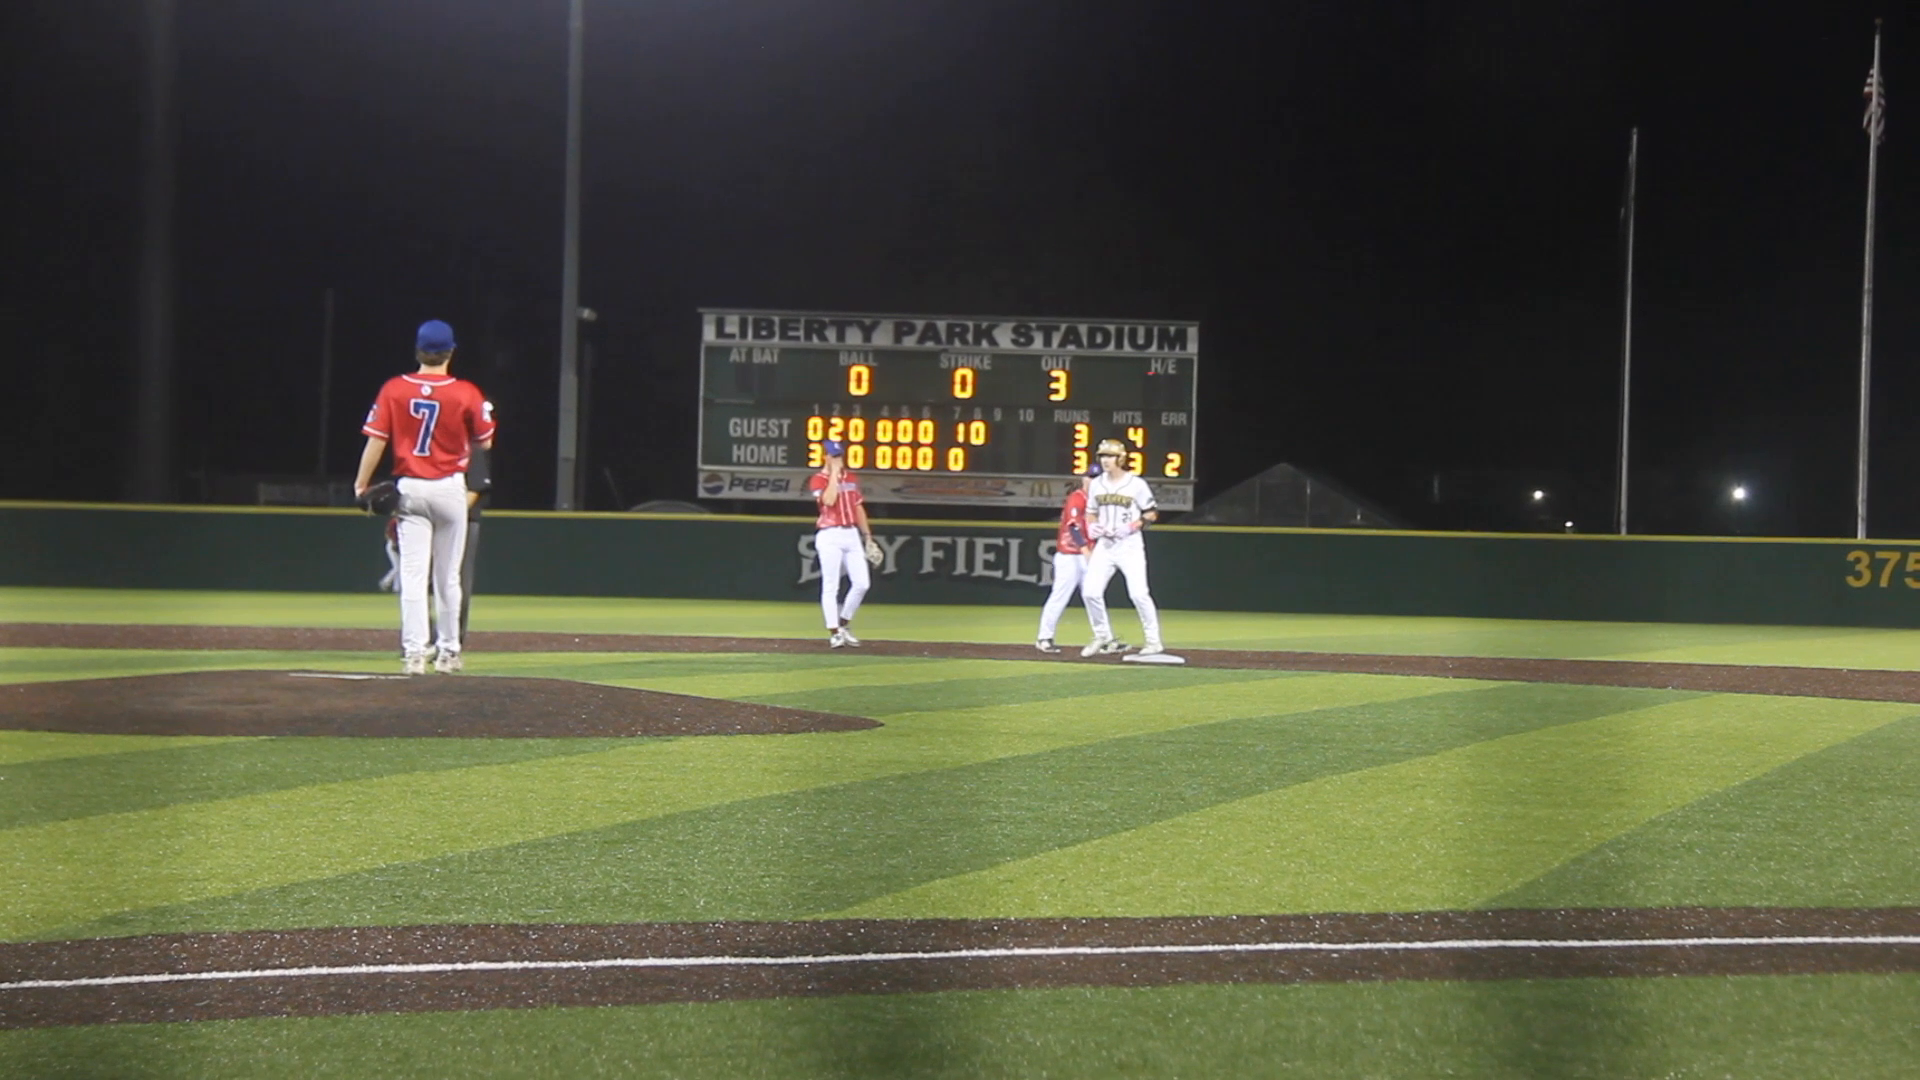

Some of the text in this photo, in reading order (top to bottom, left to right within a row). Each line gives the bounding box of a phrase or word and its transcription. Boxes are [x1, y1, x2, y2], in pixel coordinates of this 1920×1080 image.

[714, 316, 1188, 351] LIBERTY PARK STADIUM
[729, 350, 779, 364] AT BAT
[839, 351, 878, 366] BALL
[940, 354, 992, 370] STRIKE
[1041, 356, 1073, 371] OUT
[1151, 359, 1176, 374] H/E
[849, 365, 870, 396] 0
[953, 367, 974, 399] 0
[1048, 370, 1067, 401] 3
[812, 404, 820, 416] 1
[832, 403, 841, 416] 2
[1018, 409, 1034, 422] 10
[1054, 410, 1090, 423] RUNS
[1113, 411, 1142, 424] HITS
[1161, 412, 1187, 426] ERR
[410, 398, 440, 457] 7
[729, 417, 791, 438] GUEST
[1074, 424, 1088, 448] 3
[1127, 427, 1143, 448] 4
[732, 444, 787, 464] HOME
[1073, 451, 1088, 475] 3
[1127, 452, 1142, 476] 3
[1164, 453, 1181, 477] 2
[728, 475, 790, 493] PEPSI
[1845, 549, 1920, 589] 375
